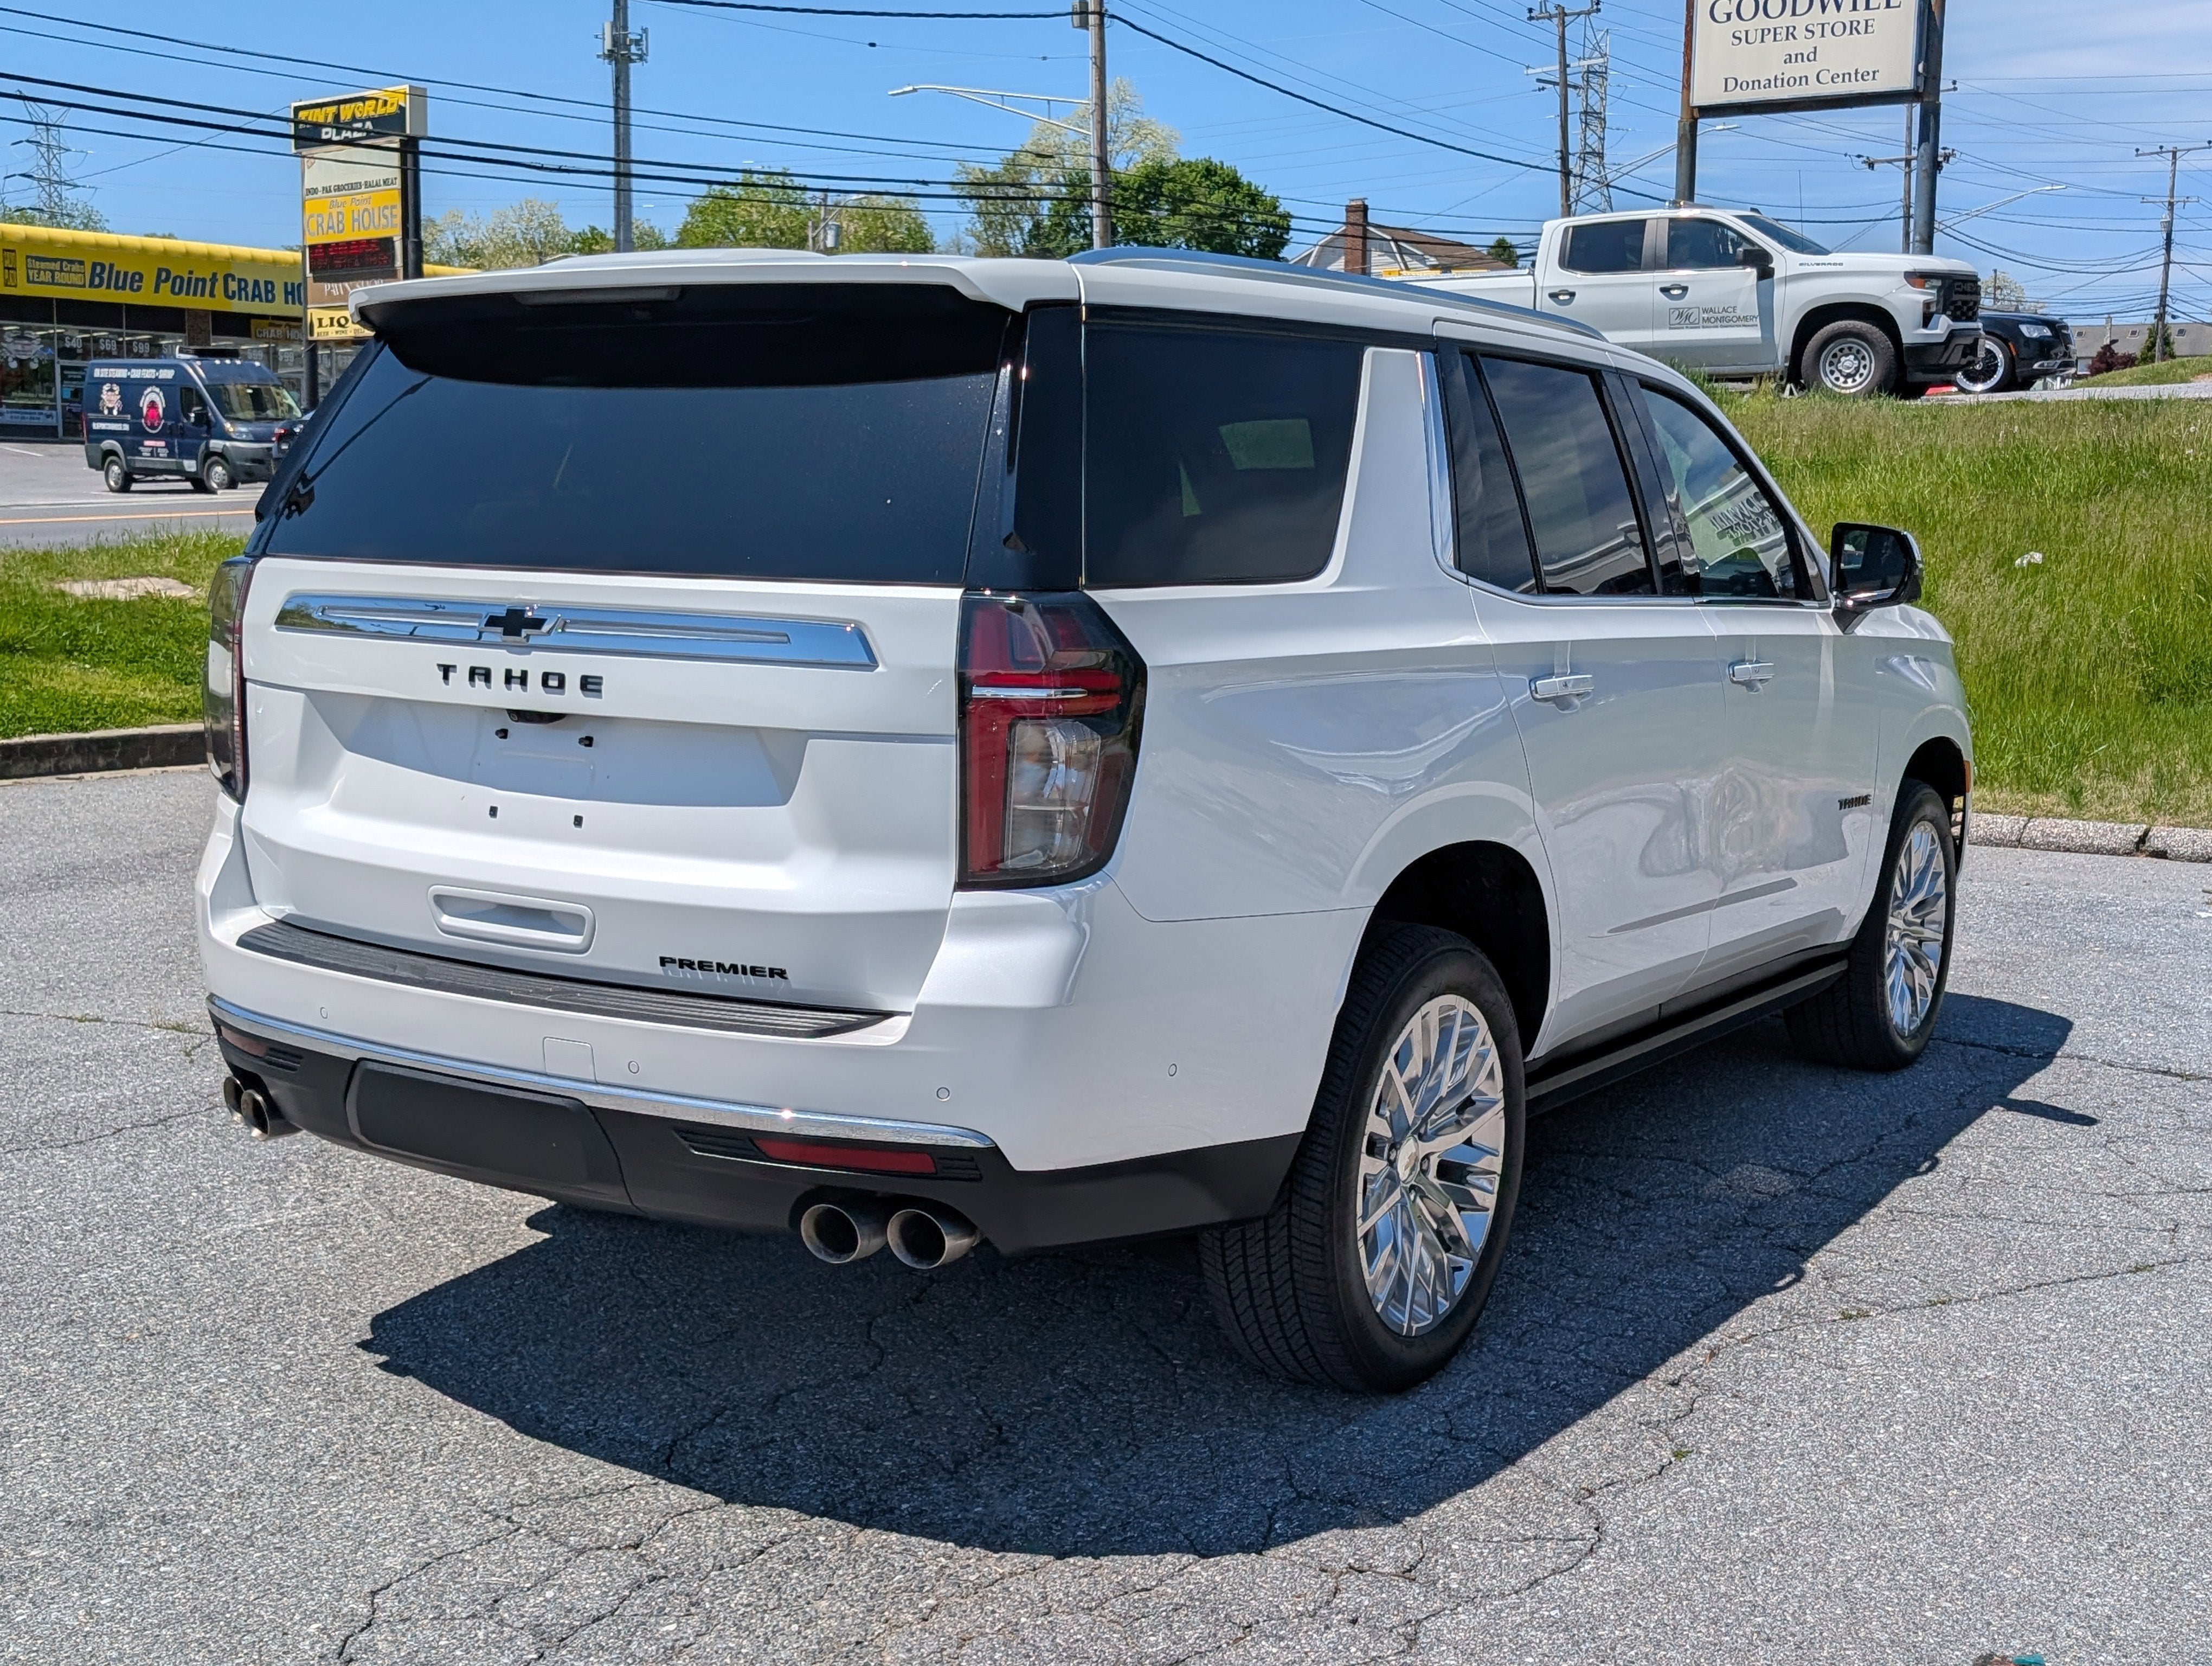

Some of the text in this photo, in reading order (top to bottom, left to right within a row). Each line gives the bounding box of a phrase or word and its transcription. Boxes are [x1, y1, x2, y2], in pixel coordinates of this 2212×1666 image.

[1709, 0, 1902, 23] GOODWILL
[1731, 18, 1875, 46] SUPER STORE
[1783, 46, 1818, 65] and
[1723, 68, 1880, 93] Donation Center
[298, 97, 399, 124] TINT WORLD
[382, 177, 398, 186] MEAT
[329, 196, 372, 209] Blue Point
[307, 204, 398, 236] CRAB HOUSE
[28, 270, 52, 283] YEAR
[88, 261, 144, 292] Blue
[153, 267, 218, 298] Point
[223, 273, 276, 304] CRAB
[1702, 306, 1737, 314] WALLACE
[1702, 315, 1759, 324] MONTGOMERY
[436, 663, 604, 693] TAHOE
[659, 956, 789, 980] PREMIER
